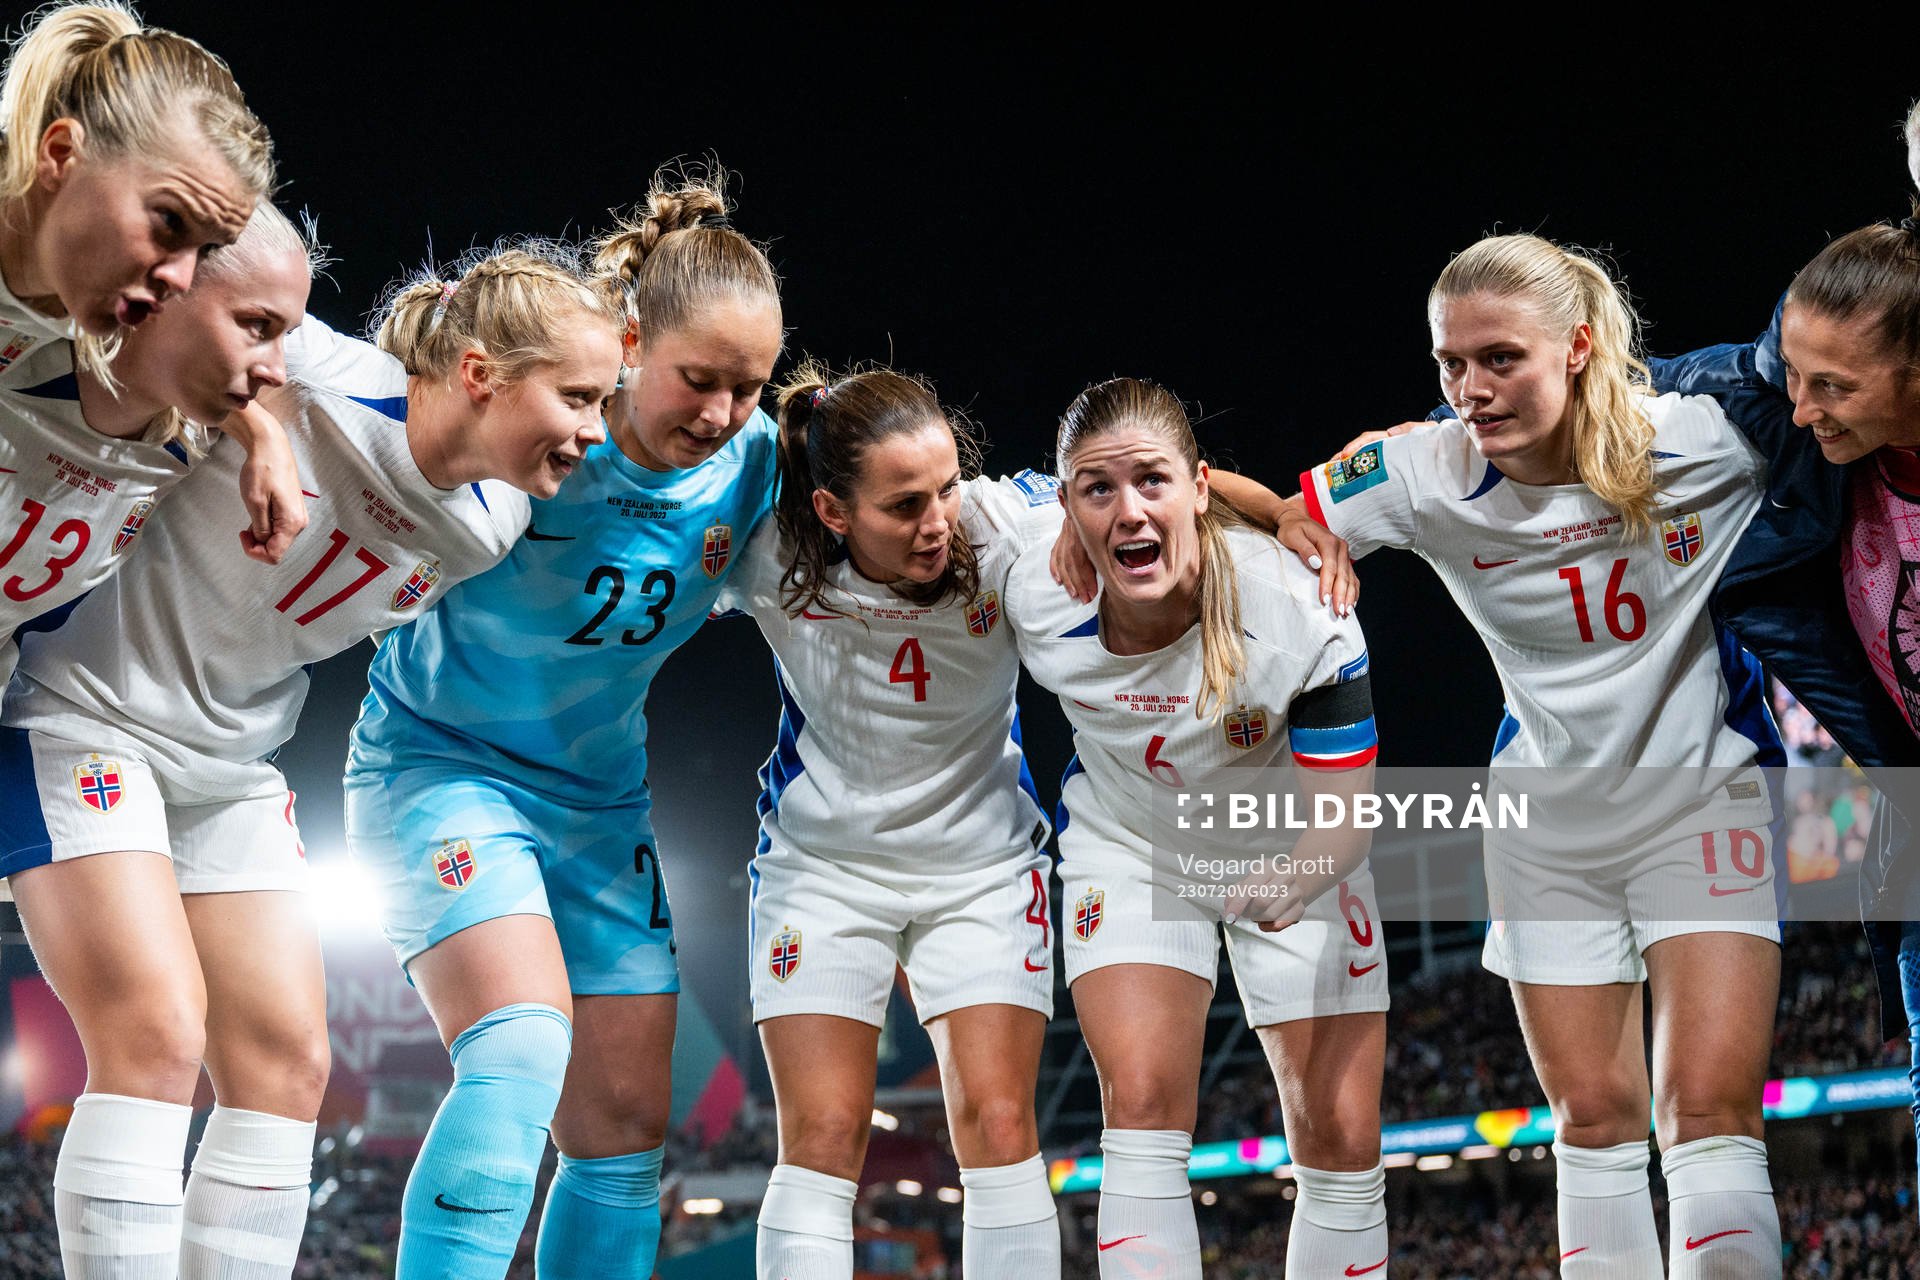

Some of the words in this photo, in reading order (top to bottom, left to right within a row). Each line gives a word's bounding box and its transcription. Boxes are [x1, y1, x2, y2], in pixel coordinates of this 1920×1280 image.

[47, 452, 64, 466] NEW
[62, 460, 91, 480] ZEALAND
[94, 476, 117, 493] NORGE
[81, 481, 99, 497] 2023
[373, 498, 397, 518] ZEALAND
[606, 496, 623, 506] NEW
[624, 499, 655, 510] ZEALAND
[661, 501, 683, 511] NORGE
[633, 510, 648, 519] JULI
[649, 511, 667, 519] 2023
[1543, 528, 1559, 539] NEW
[1560, 521, 1591, 535] ZEALAND
[1597, 514, 1622, 527] NORGE
[1573, 532, 1589, 541] JULI
[1589, 527, 1609, 538] 2023
[0, 497, 91, 602] 13
[274, 527, 390, 626] 17
[563, 565, 676, 646] 23
[1558, 558, 1647, 642] 16
[889, 637, 931, 703] 4
[1115, 694, 1129, 702] NEW
[1131, 695, 1160, 704] ZEALAND
[1166, 696, 1190, 704] NORGE
[1142, 704, 1157, 712] JULI
[1158, 705, 1176, 713] 2023
[1144, 735, 1185, 788] 6
[1026, 869, 1049, 948] 4
[1338, 880, 1374, 948] 6
